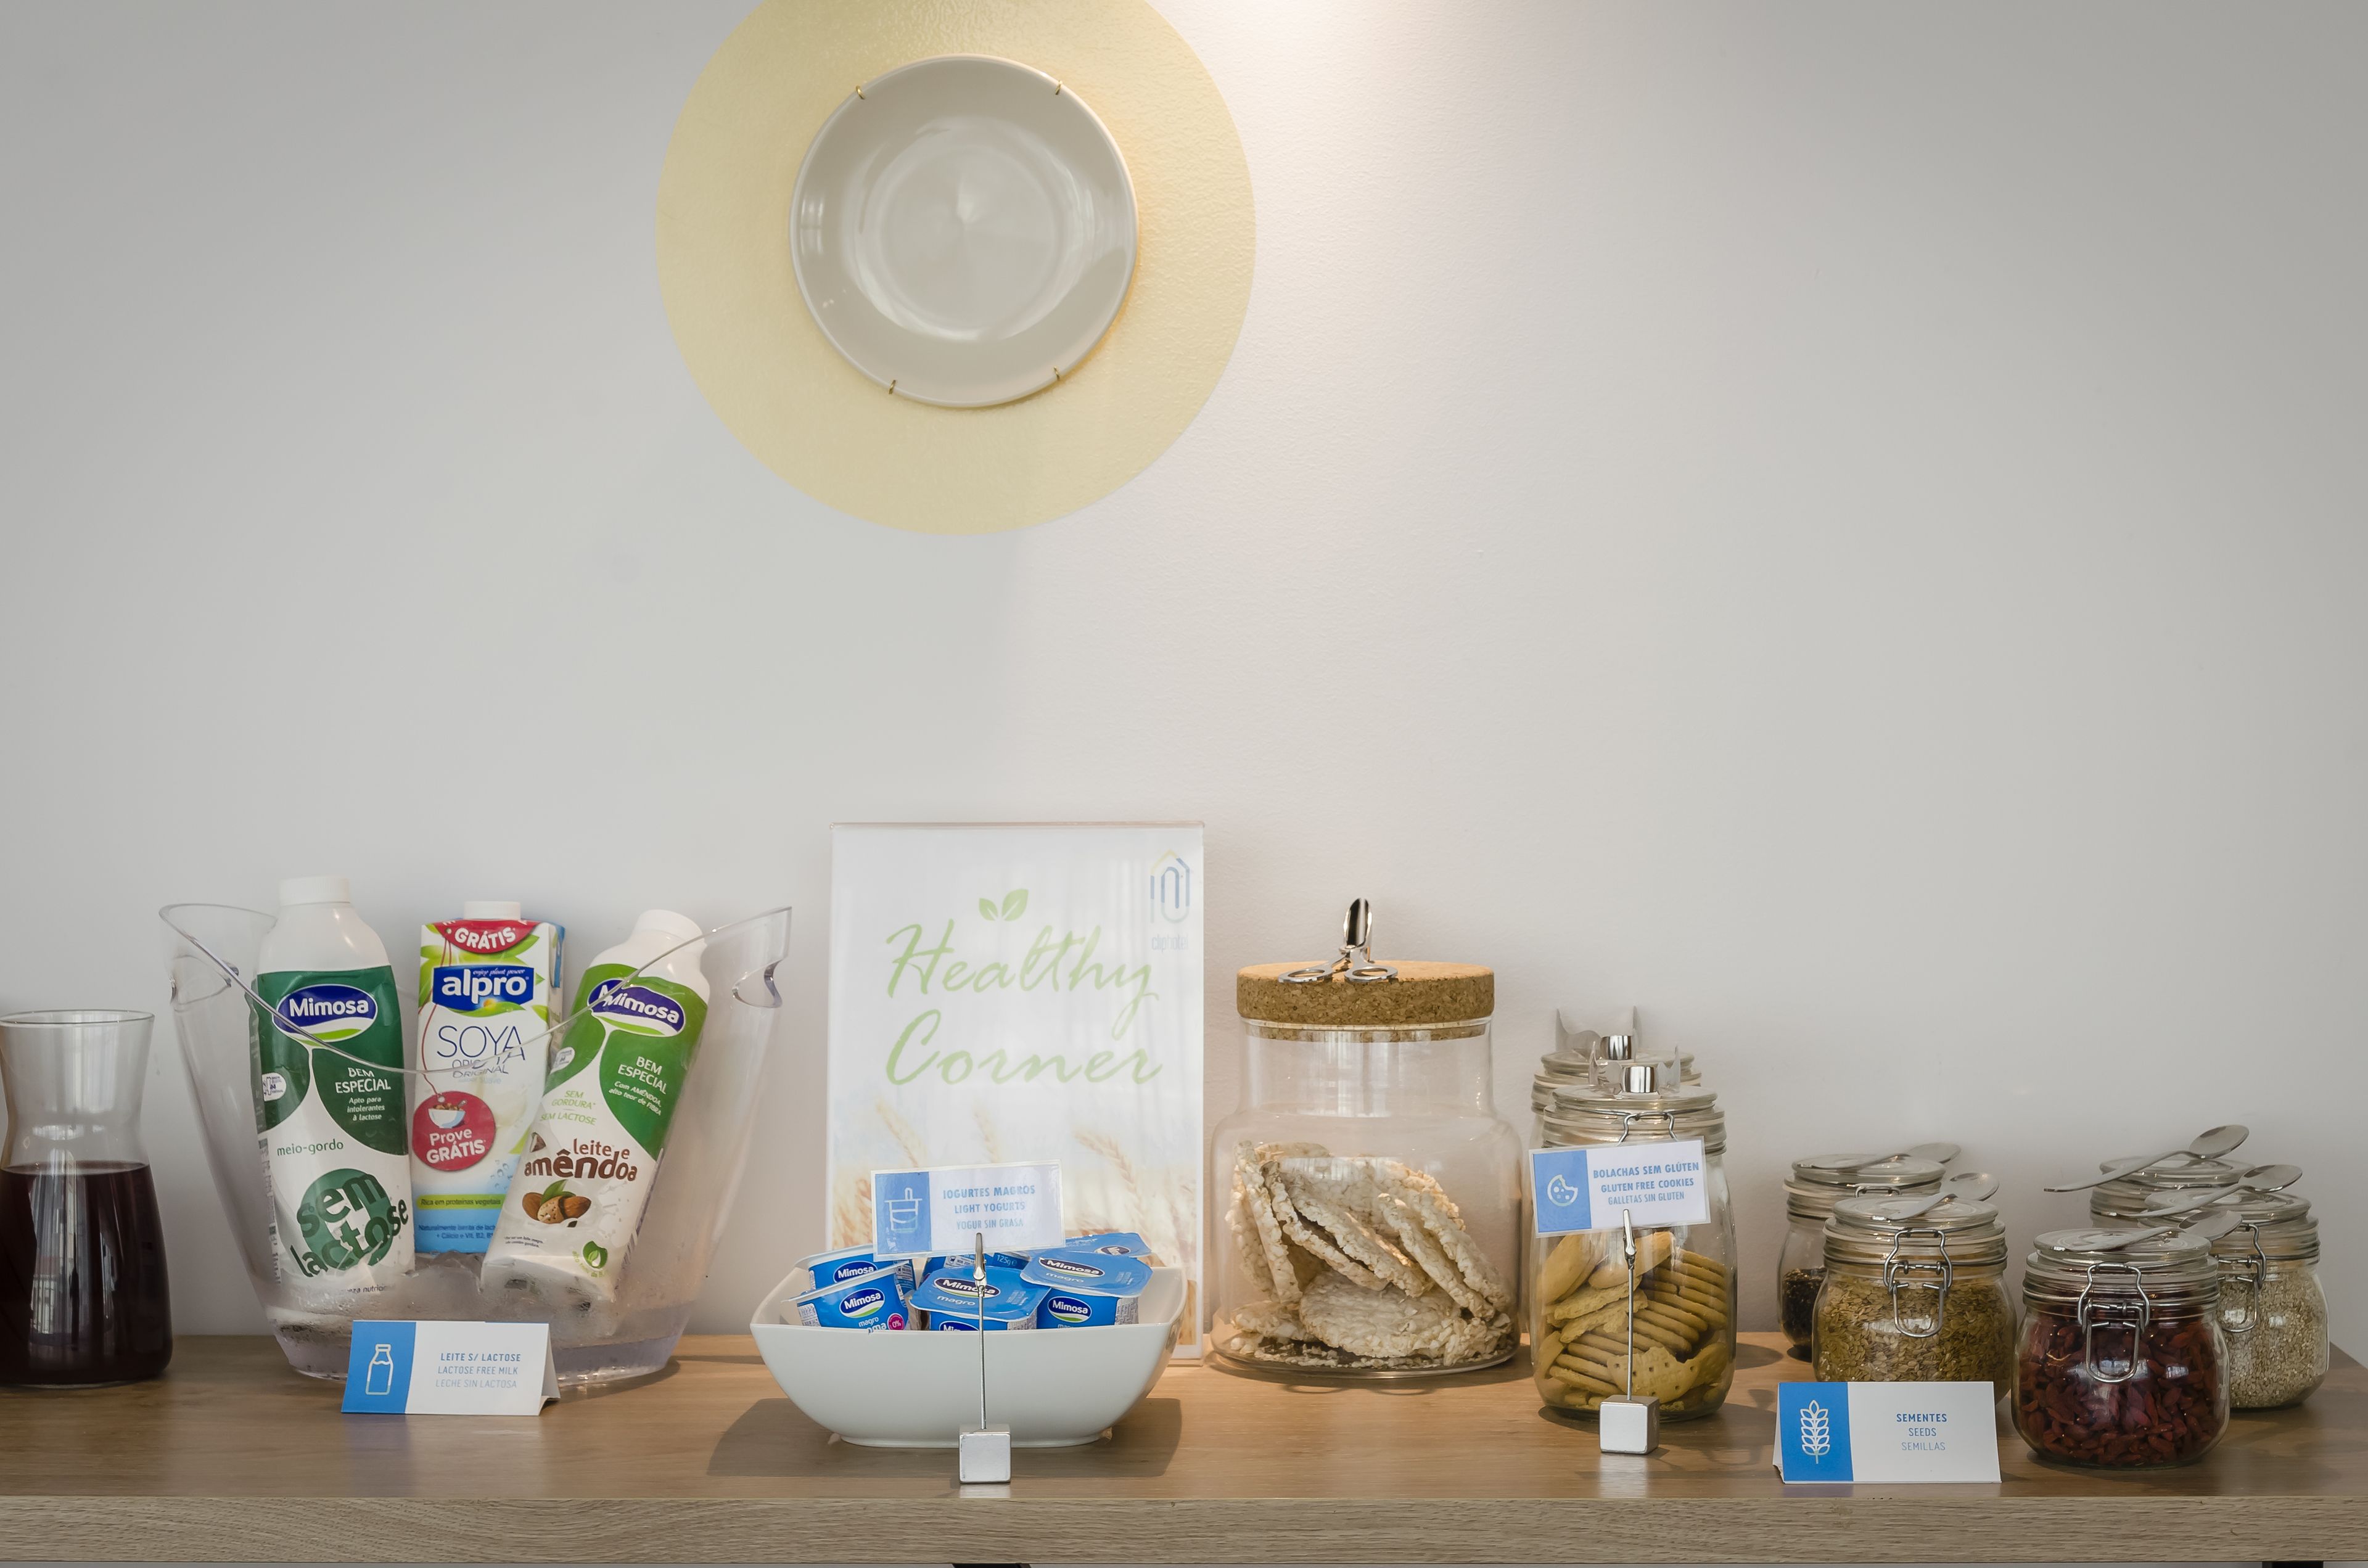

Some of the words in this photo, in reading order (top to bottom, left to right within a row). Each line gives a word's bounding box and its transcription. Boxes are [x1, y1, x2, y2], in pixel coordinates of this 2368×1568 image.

[454, 927, 516, 950] GRÁTIS
[442, 969, 527, 1004] alpro
[886, 919, 1160, 1041] Healthy
[289, 998, 369, 1017] Mimosa
[602, 991, 680, 1024] Mimosa
[437, 1025, 524, 1058] SOYA
[886, 1009, 1163, 1085] Corner
[348, 1067, 375, 1077] BEM
[636, 1056, 662, 1075] BEM
[335, 1078, 391, 1094] ESPECIAL
[614, 1081, 630, 1090] Com
[618, 1064, 667, 1094] ESPECIAL
[349, 1097, 364, 1105] Apto
[565, 1090, 583, 1098] SEM
[623, 1092, 637, 1101] teor
[638, 1098, 646, 1106] de
[347, 1104, 385, 1113] intolerantes
[359, 1113, 382, 1121] lactose
[540, 1112, 556, 1120] SEM
[557, 1112, 597, 1125] LACTOSE
[429, 1129, 472, 1146] Prove
[277, 1139, 343, 1156] meio-gordo
[426, 1139, 486, 1164] GRÁTIS
[573, 1138, 612, 1157] leite
[621, 1147, 630, 1159] e
[524, 1149, 638, 1181] amêndoa
[1593, 1167, 1640, 1179] BOLACHAS
[1643, 1164, 1661, 1175] SEM
[1665, 1162, 1699, 1173] GLÚTEN
[943, 1188, 990, 1199] IOGURTES
[993, 1185, 1035, 1196] MAGROS
[1601, 1183, 1634, 1193] GLUTEN
[1635, 1181, 1655, 1191] FREE
[1658, 1178, 1694, 1189] COOKIES
[1608, 1194, 1642, 1205] GALLETAS
[1644, 1194, 1656, 1202] SIN
[1658, 1191, 1684, 1201] GLUTEN
[297, 1174, 387, 1238] sem
[955, 1204, 980, 1214] LIGHT
[984, 1202, 1025, 1212] YOGURTS
[956, 1220, 982, 1229] YOGUR
[984, 1220, 997, 1229] SIN
[999, 1218, 1024, 1228] GRASA
[290, 1199, 408, 1277] lactose
[997, 1254, 1011, 1266] 125g
[837, 1266, 874, 1278] Mimosa
[1046, 1260, 1099, 1275] Mimosa
[1046, 1273, 1084, 1283] magro
[844, 1292, 881, 1309] Mimosa
[937, 1296, 976, 1306] magro
[1052, 1300, 1088, 1314] Mimosa
[858, 1316, 879, 1327] magro
[440, 1353, 466, 1361] LEITE
[467, 1353, 479, 1361] S/
[481, 1353, 521, 1362] LACTOSE
[438, 1365, 474, 1374] LACTOSE
[477, 1366, 496, 1375] FREE
[498, 1366, 518, 1375] MILK
[435, 1379, 462, 1388] LECHE
[464, 1379, 477, 1388] SIN
[480, 1379, 517, 1389] LACTOSA
[1896, 1413, 1947, 1422] SEMENTES
[1908, 1427, 1936, 1437] SEEDS
[1901, 1442, 1946, 1451] SEMILLAS
